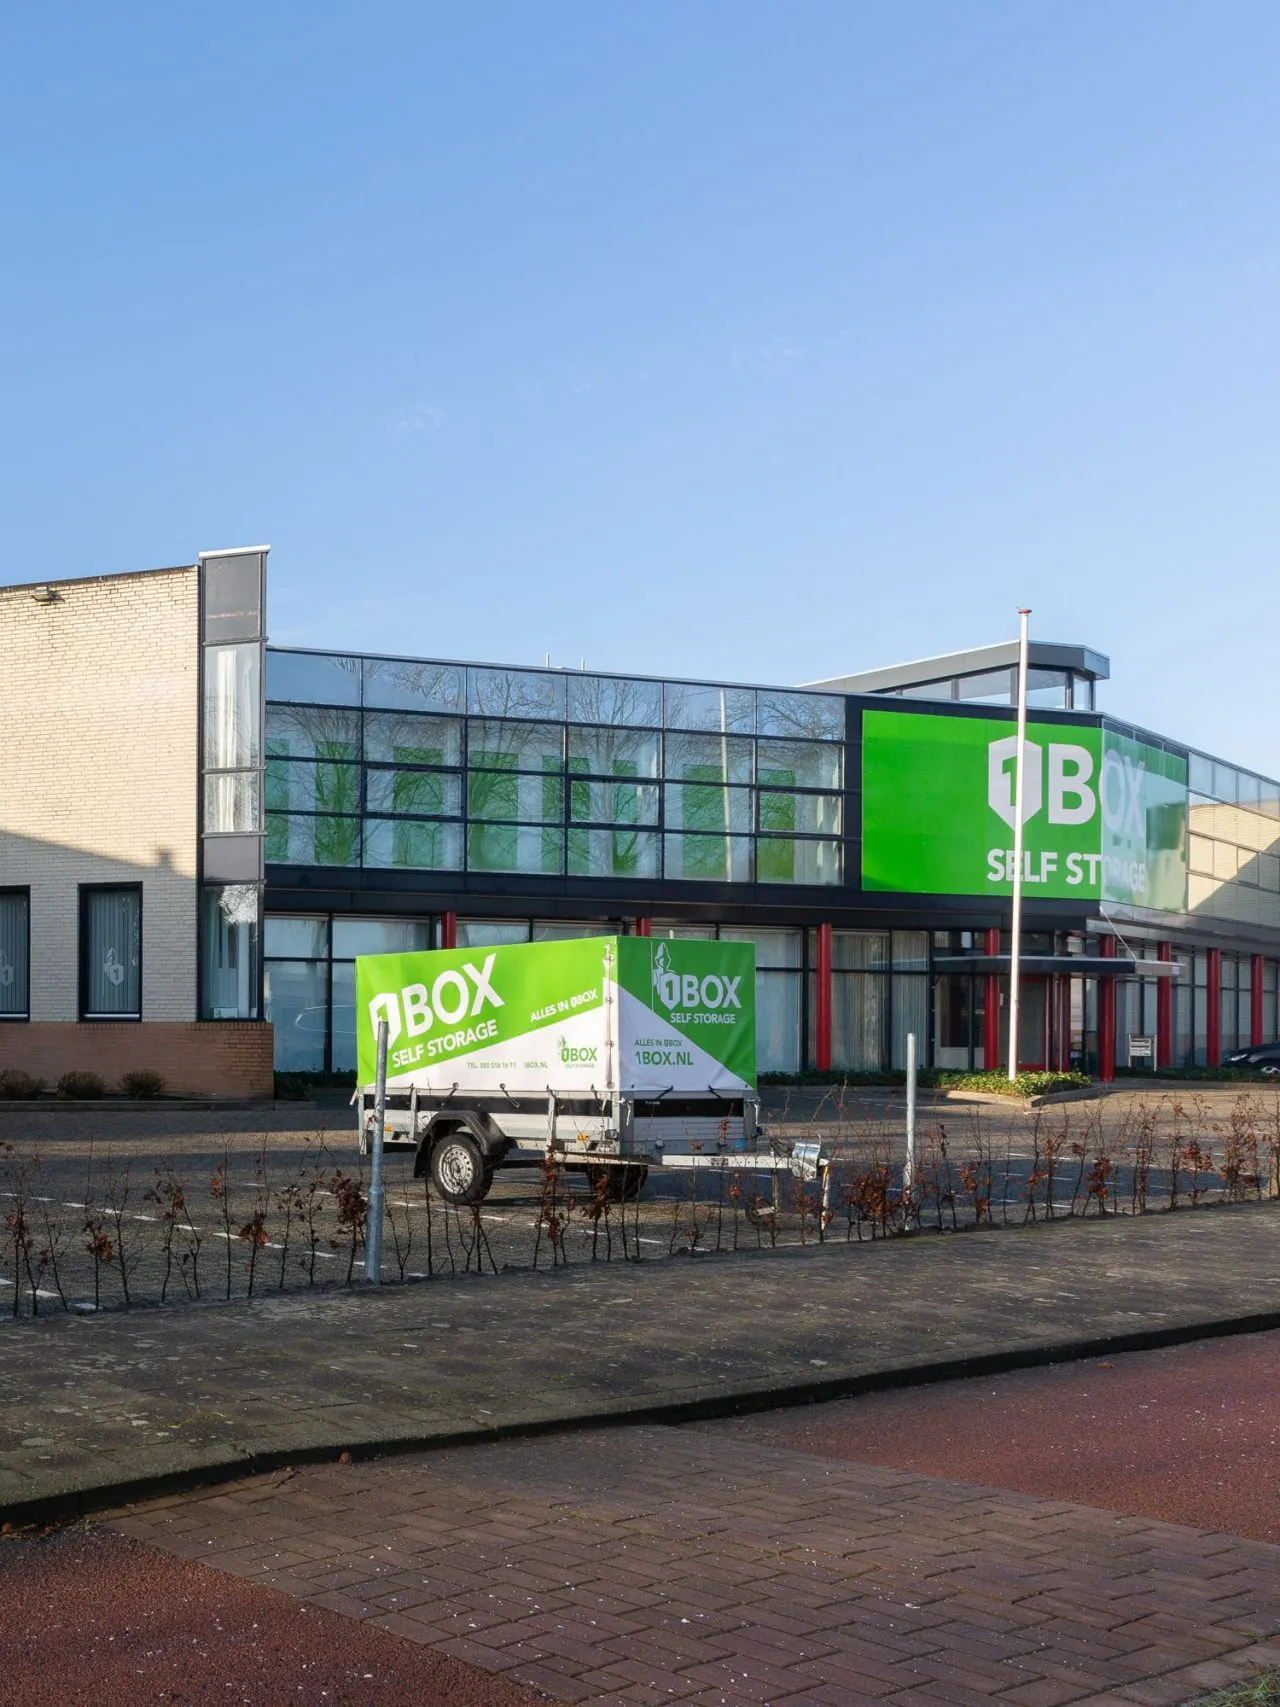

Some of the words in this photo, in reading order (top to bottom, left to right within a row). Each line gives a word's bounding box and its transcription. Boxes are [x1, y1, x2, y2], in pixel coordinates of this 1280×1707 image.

[987, 848, 1058, 883] SELF
[1065, 852, 1146, 893] STORAGE
[530, 1004, 557, 1023] ALLES
[558, 1000, 569, 1012] IN
[670, 1012, 693, 1023] SELF
[693, 1012, 736, 1024] STORAGE
[392, 1043, 424, 1068] SELF
[427, 1019, 498, 1057] STORAGE
[635, 1051, 694, 1065] 1BOX.NL
